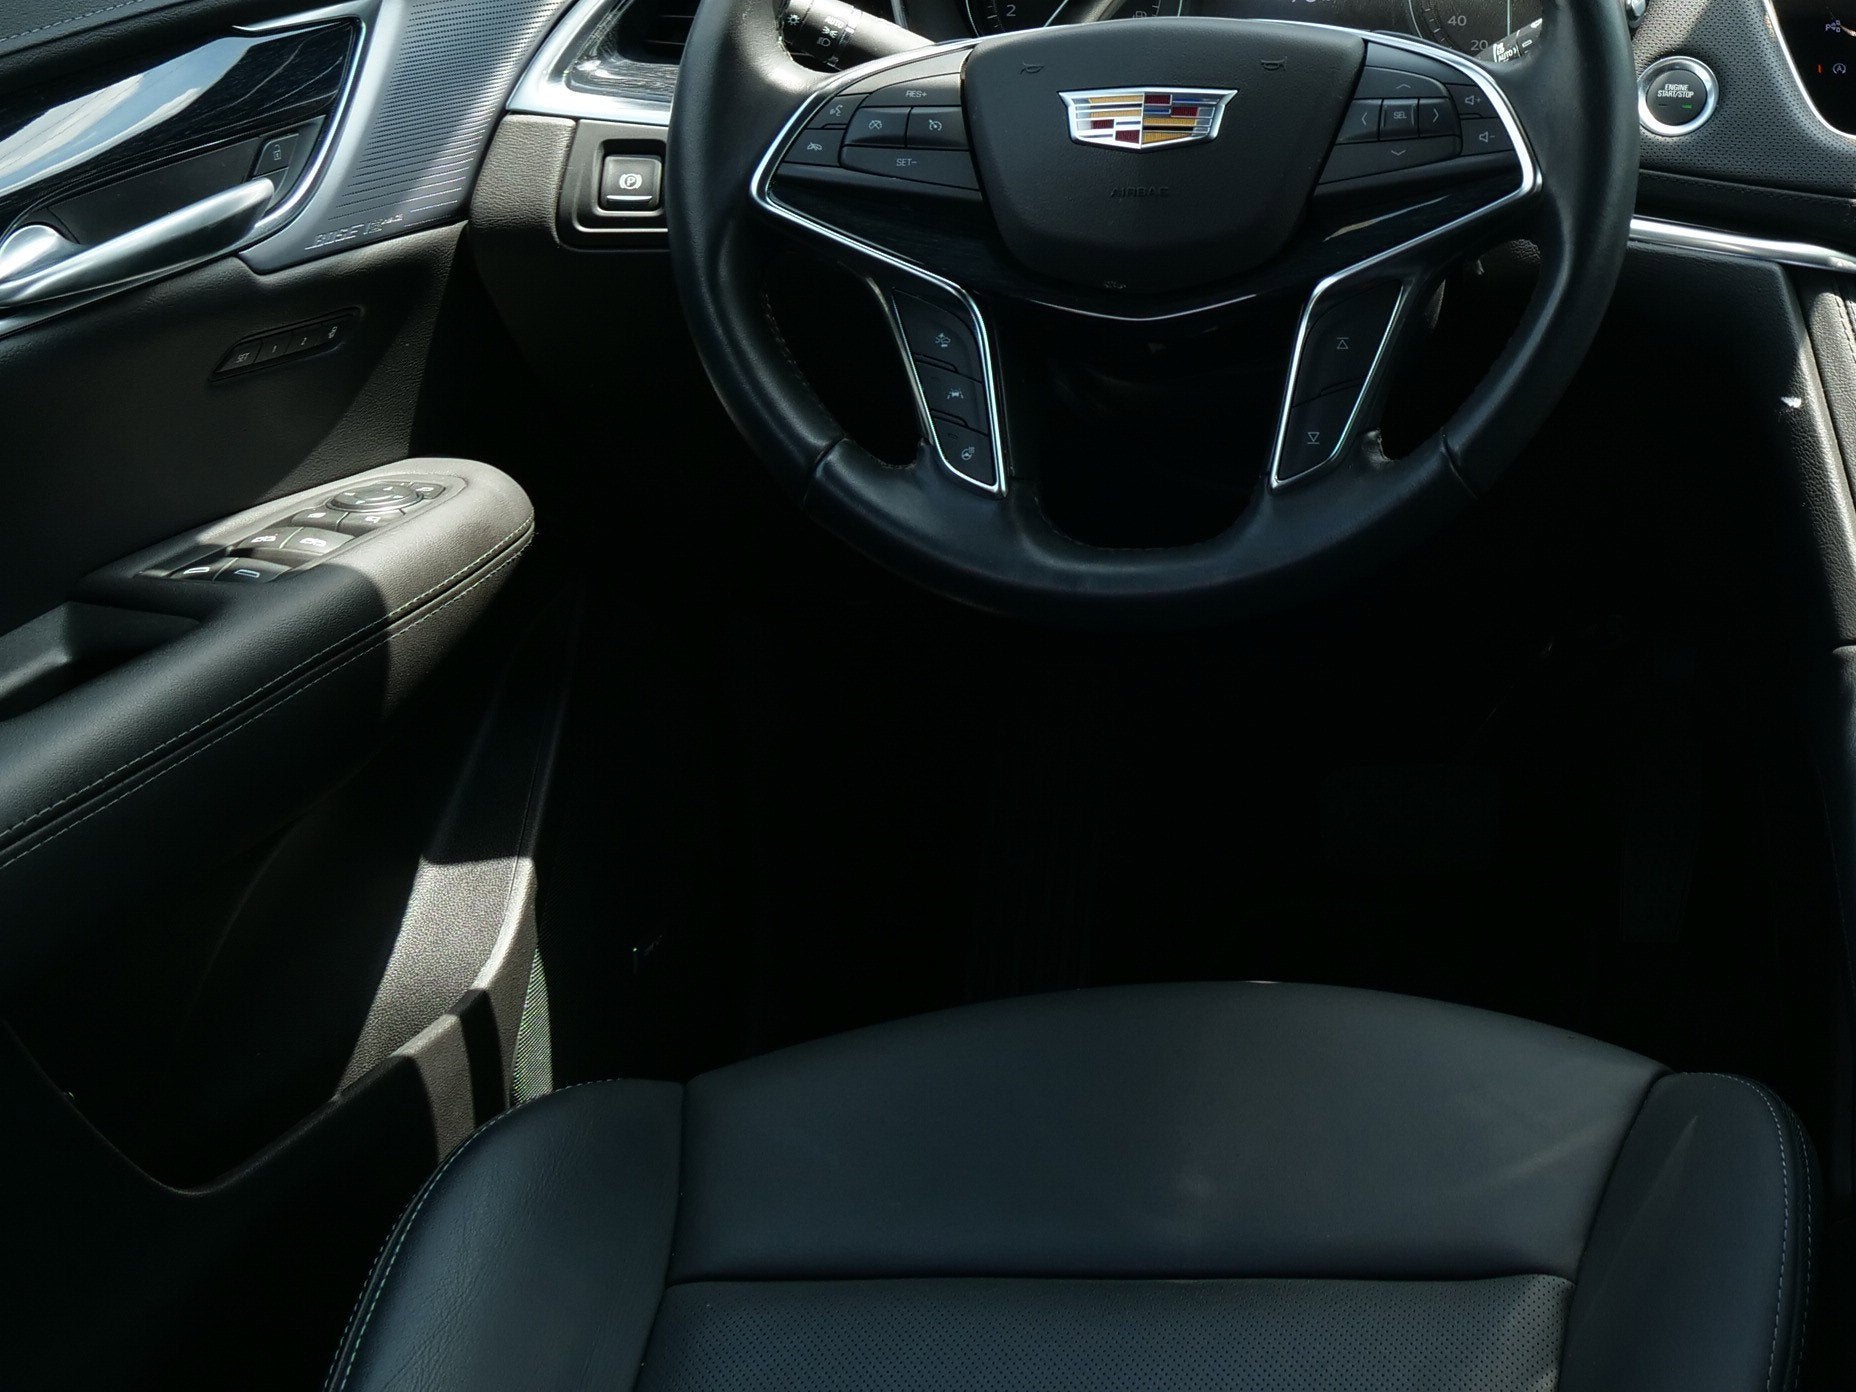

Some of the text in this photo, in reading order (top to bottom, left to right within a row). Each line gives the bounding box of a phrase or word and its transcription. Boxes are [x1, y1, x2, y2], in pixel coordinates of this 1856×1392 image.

[1006, 4, 1016, 17] 2
[1447, 15, 1467, 26] 40
[1470, 39, 1488, 51] 20
[1664, 83, 1690, 91] ENGINE
[1657, 90, 1695, 99] START/STOP
[1393, 111, 1407, 120] SEL
